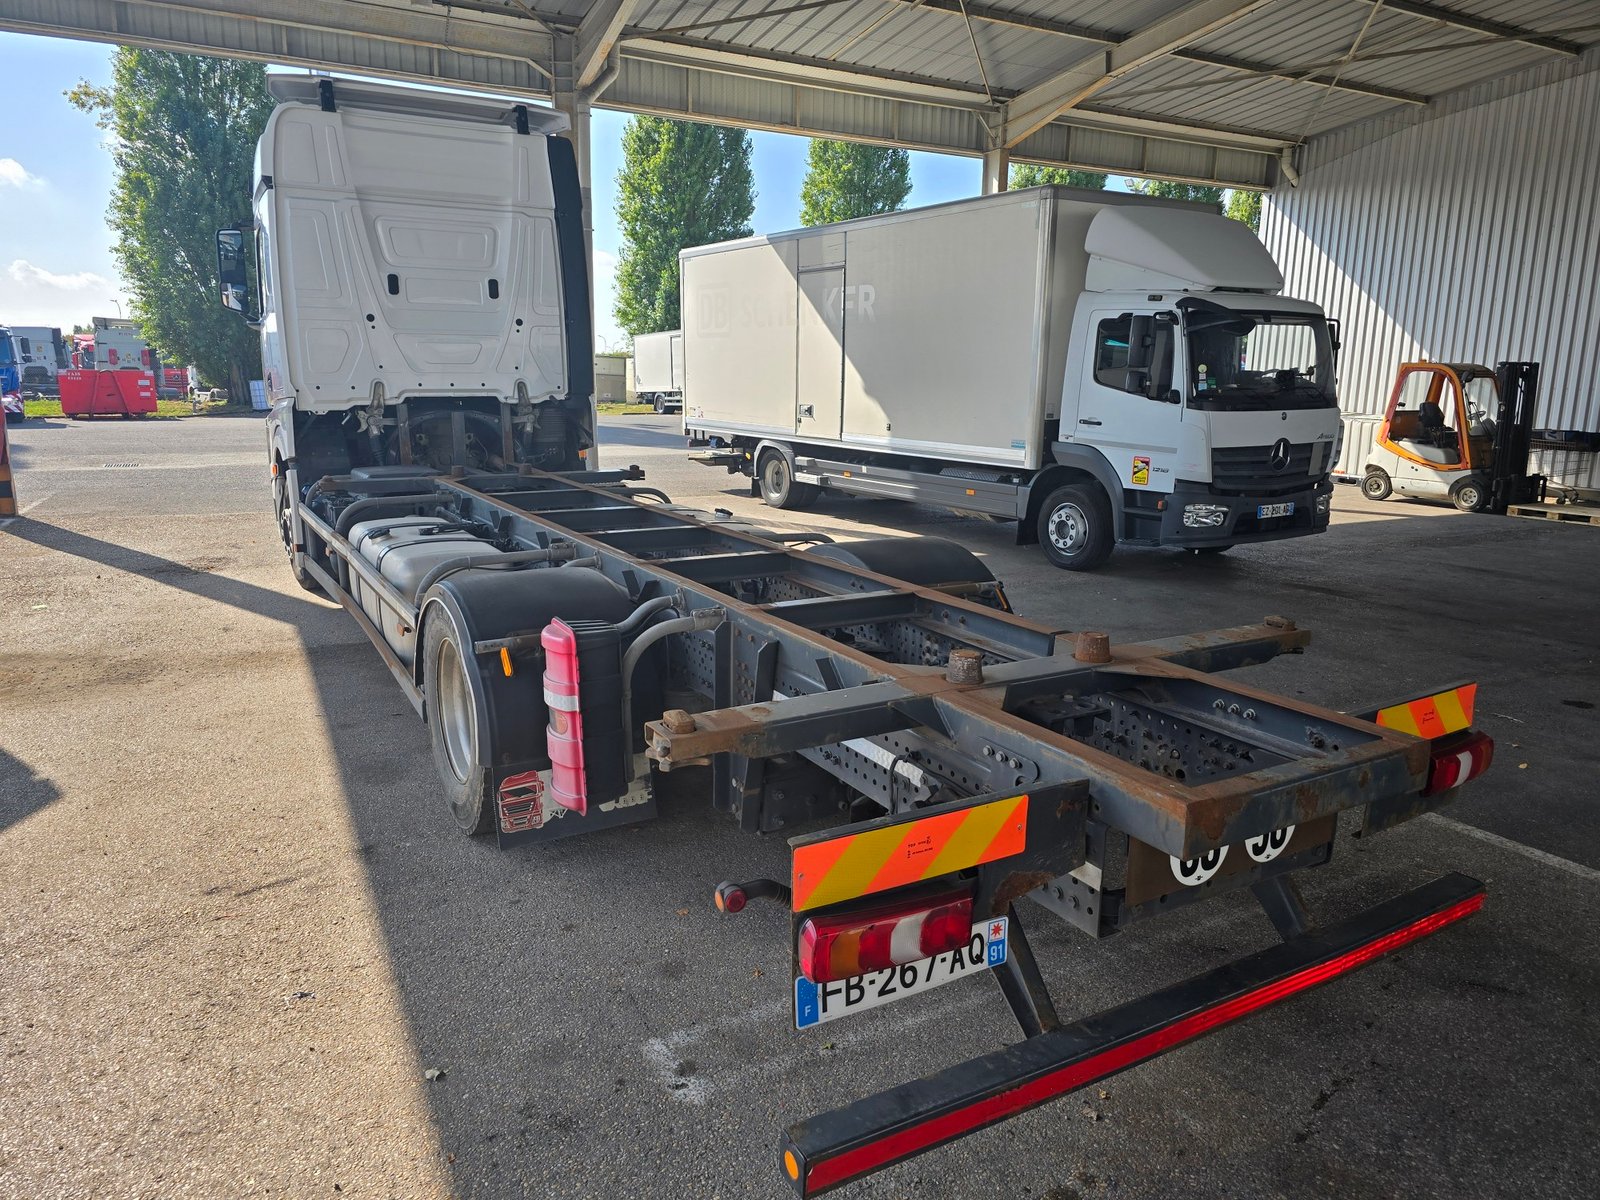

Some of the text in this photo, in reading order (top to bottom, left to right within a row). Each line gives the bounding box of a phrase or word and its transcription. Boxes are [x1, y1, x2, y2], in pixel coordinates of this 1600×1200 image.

[741, 284, 877, 328] SCHEKER
[990, 942, 1004, 961] 91
[821, 933, 985, 1013] FB-267-AQ
[804, 1004, 811, 1018] F
